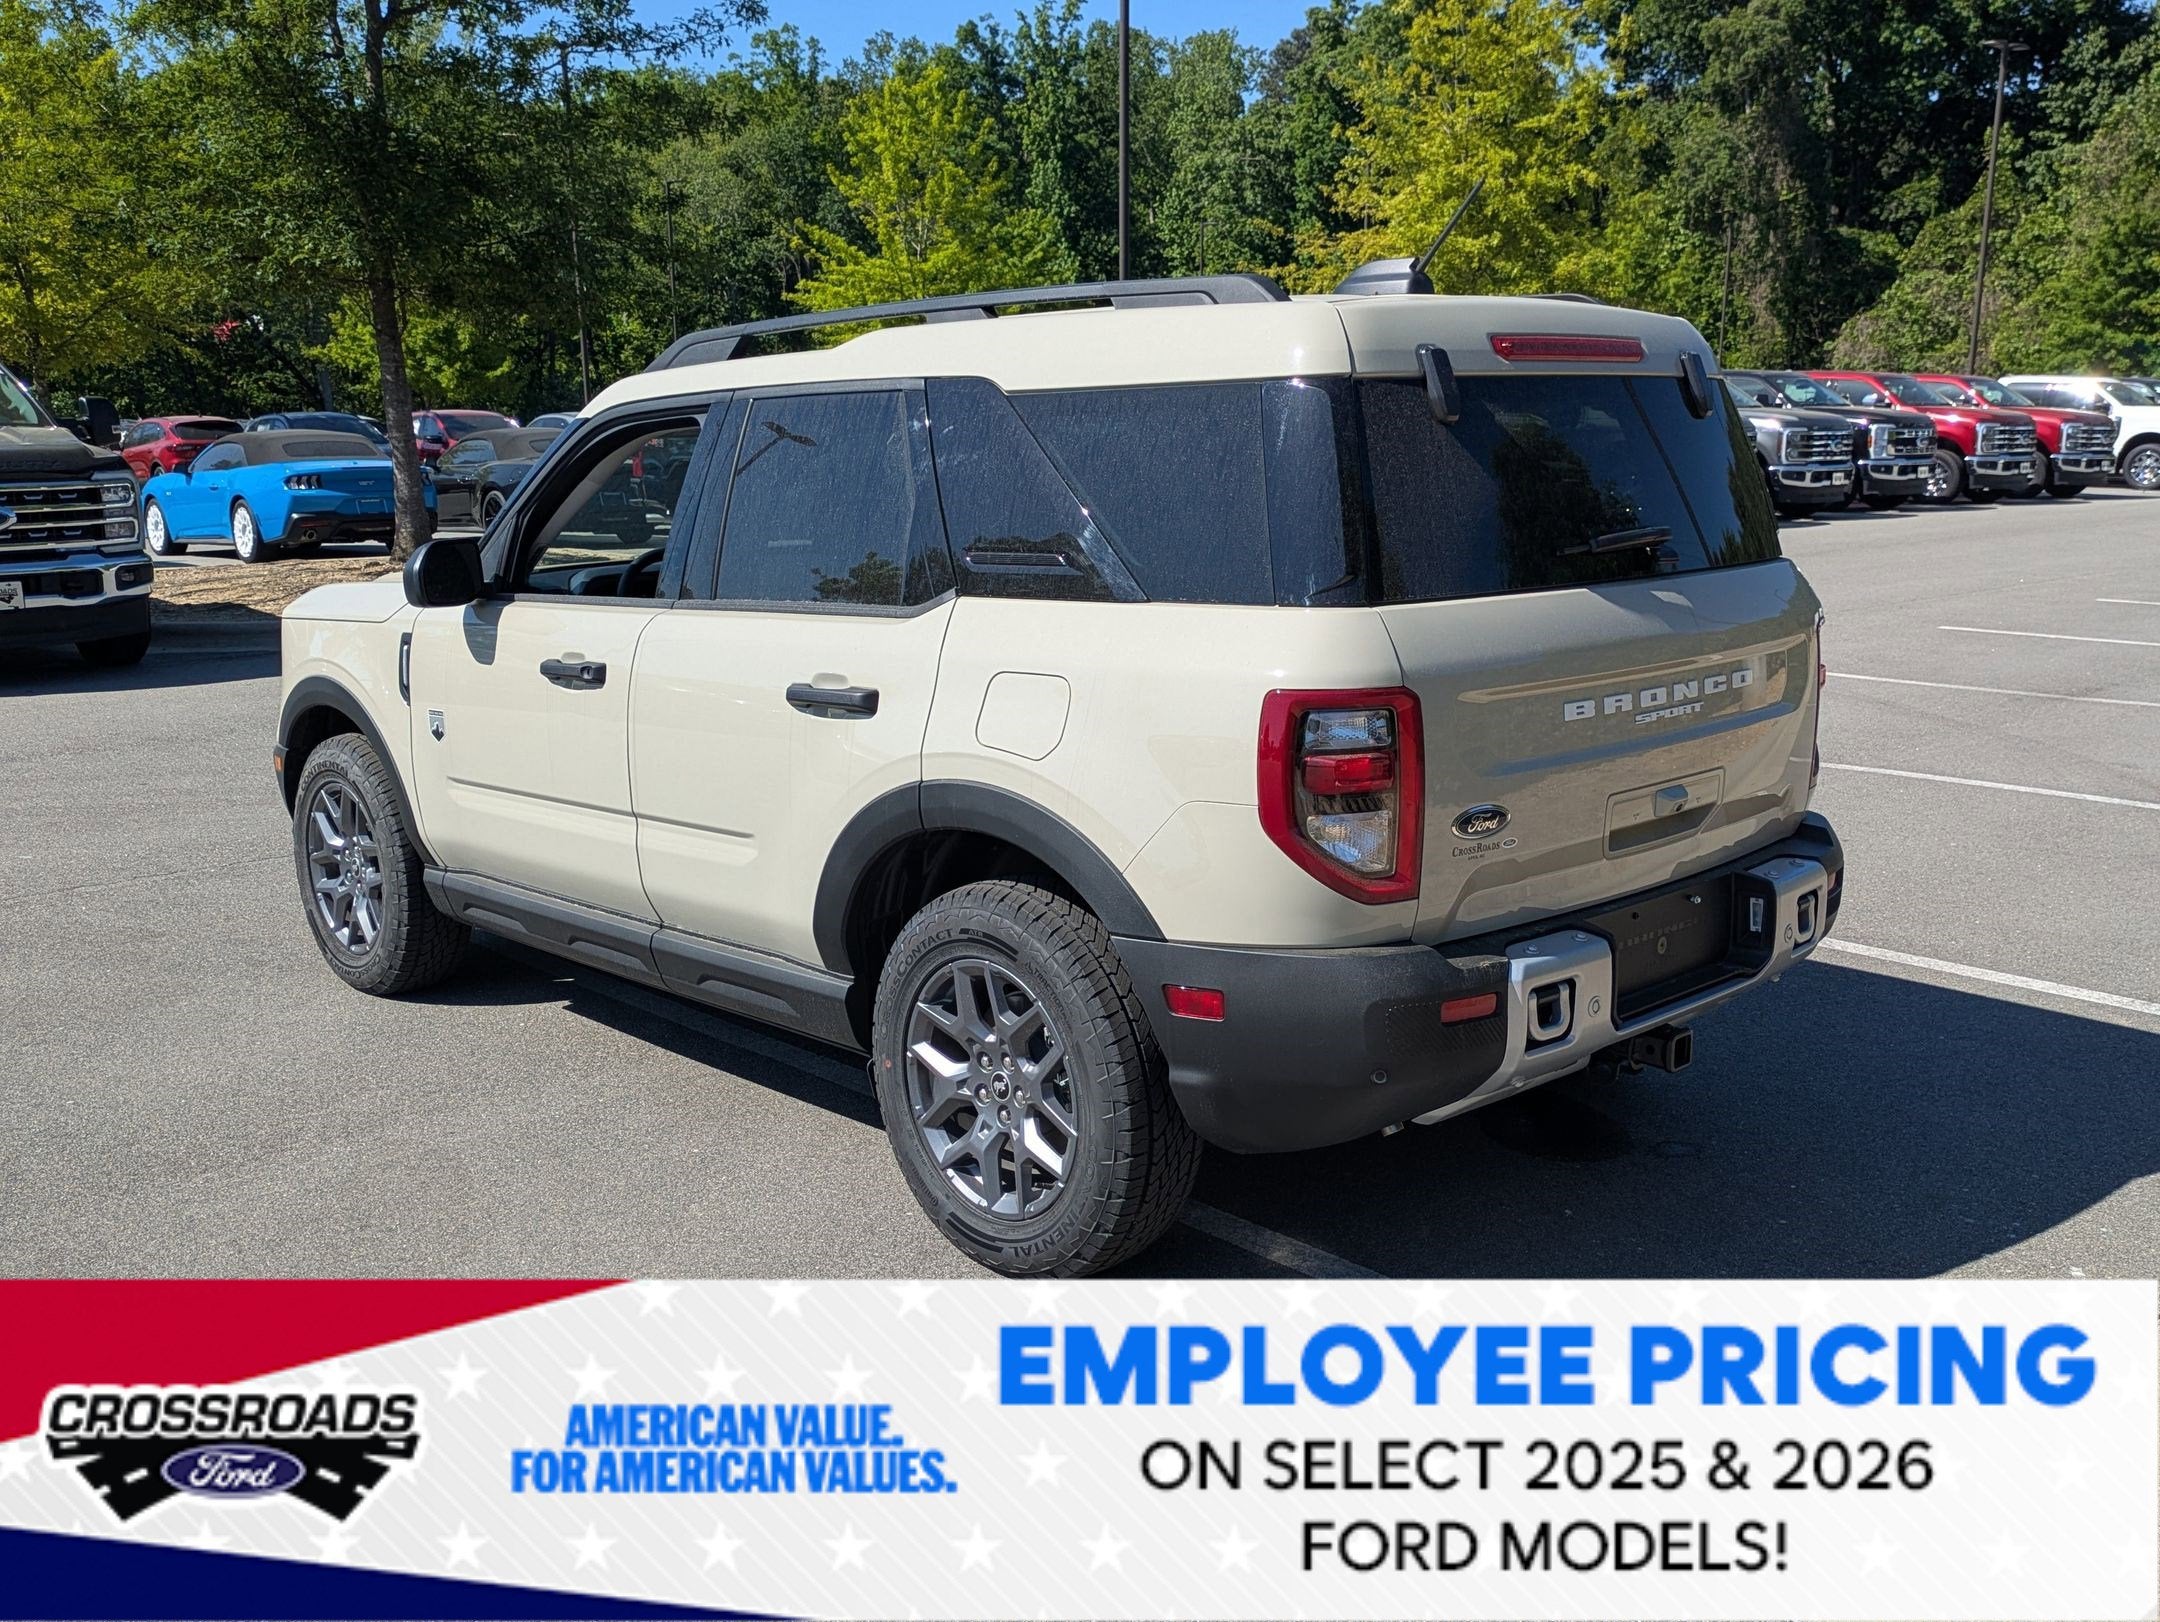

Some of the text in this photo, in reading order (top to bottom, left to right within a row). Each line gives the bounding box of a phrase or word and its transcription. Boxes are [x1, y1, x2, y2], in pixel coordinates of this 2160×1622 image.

[1564, 670, 1752, 722] BRONCO
[1635, 702, 1704, 725] SPORT
[1467, 813, 1500, 833] Ford
